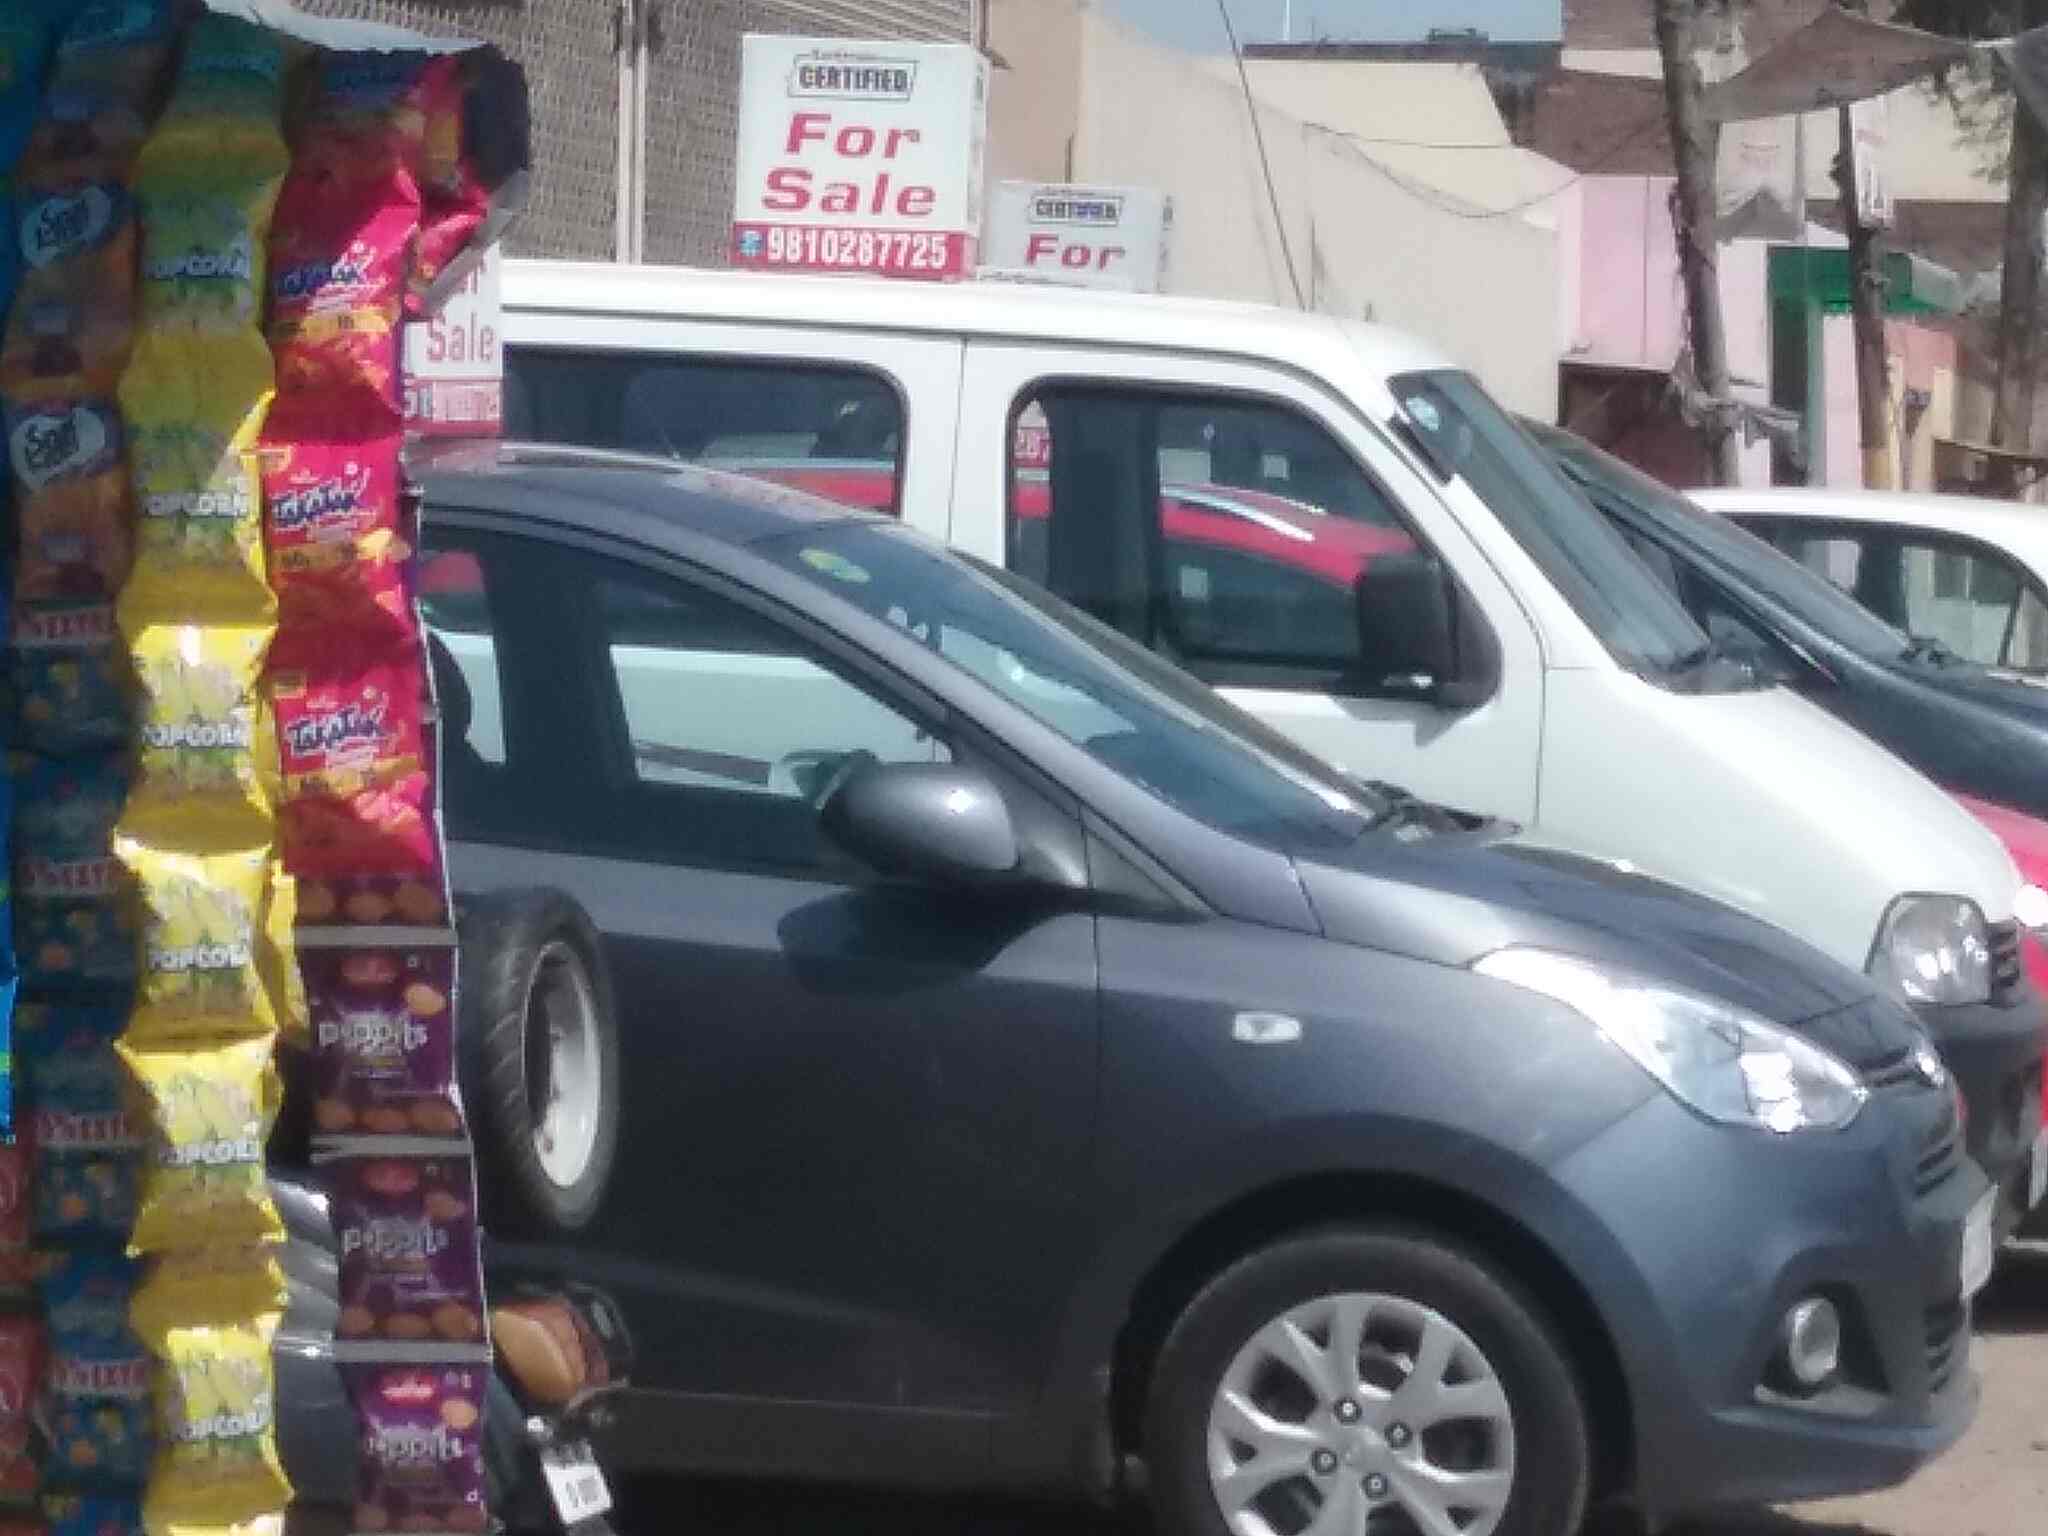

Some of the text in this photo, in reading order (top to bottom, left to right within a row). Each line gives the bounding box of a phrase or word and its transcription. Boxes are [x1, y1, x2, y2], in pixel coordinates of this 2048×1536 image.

[799, 64, 908, 93] CERTIFIED
[784, 111, 921, 159] For
[761, 166, 937, 217] Sale
[767, 229, 948, 269] 9810287725
[1025, 232, 1126, 271] For
[426, 310, 495, 362] Sale
